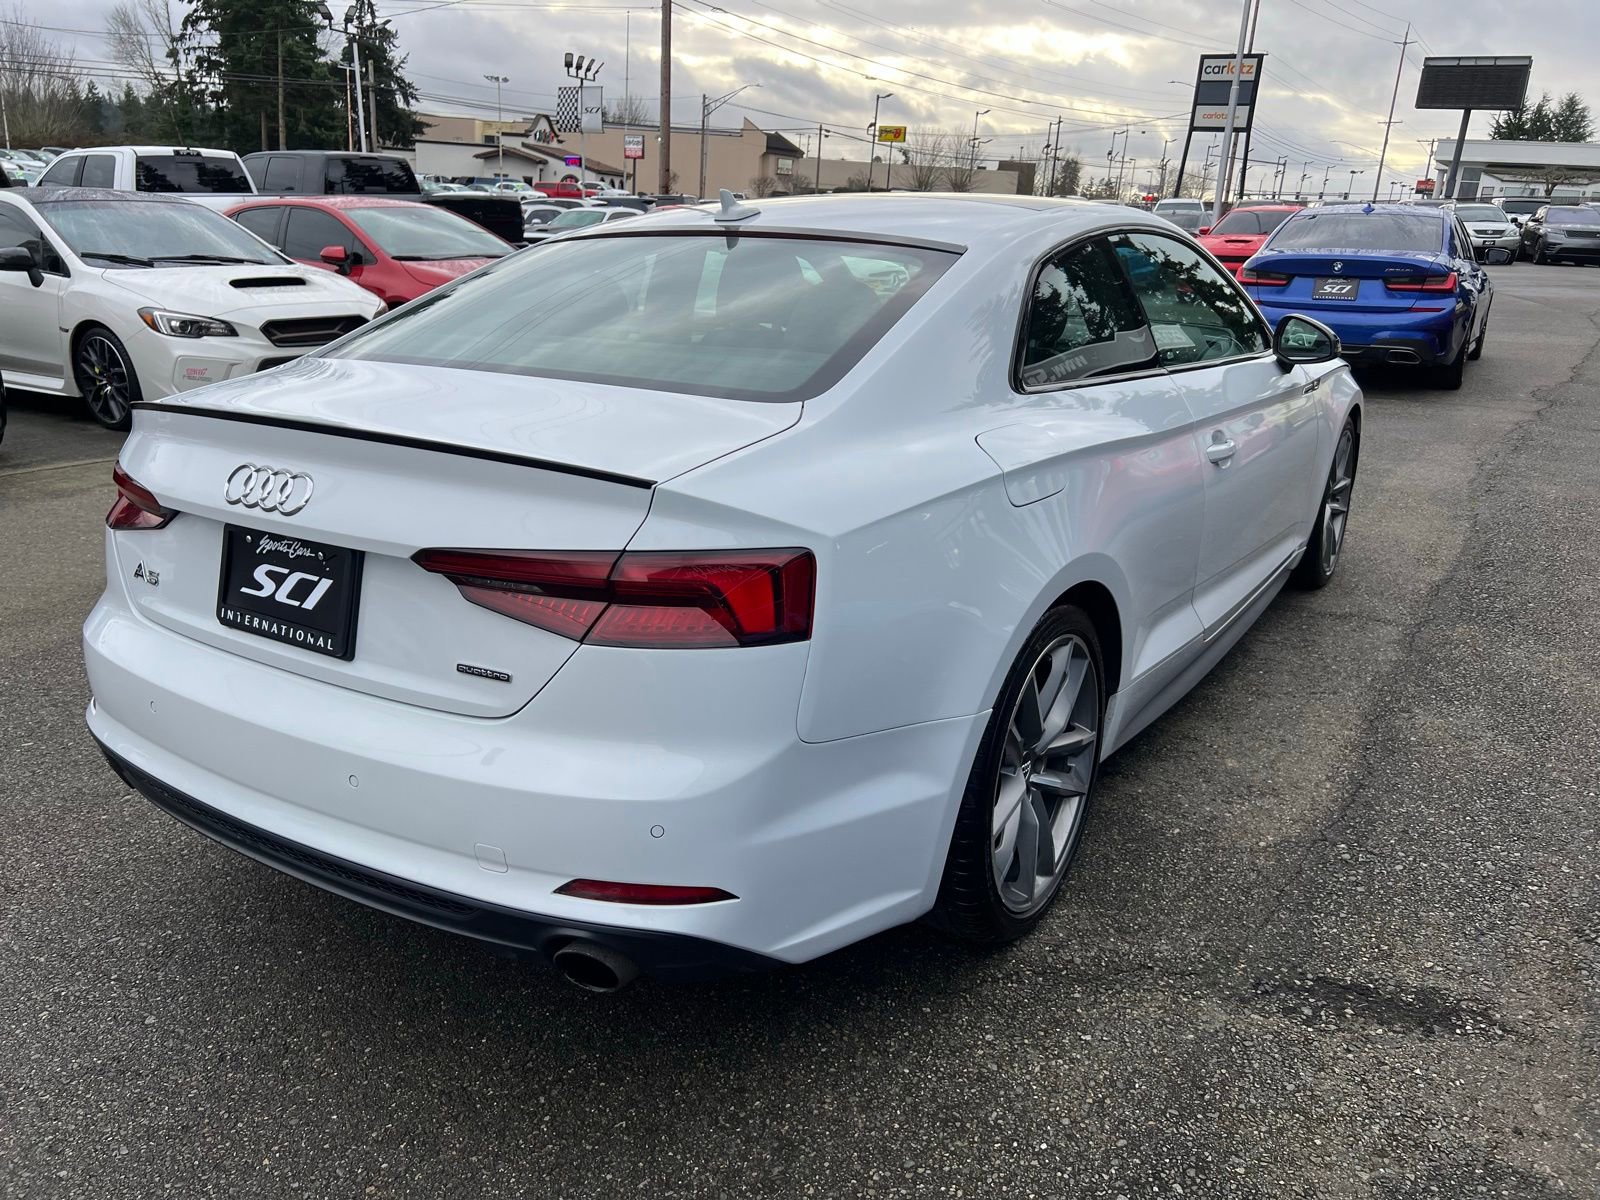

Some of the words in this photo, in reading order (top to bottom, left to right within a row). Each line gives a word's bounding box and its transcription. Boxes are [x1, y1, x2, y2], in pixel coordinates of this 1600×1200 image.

[1319, 284, 1353, 294] SCI
[255, 534, 290, 554] Sports
[287, 541, 316, 559] Cars
[134, 560, 160, 587] A5
[240, 563, 334, 611] SCI
[220, 607, 334, 651] INTERNATIONAL
[458, 665, 509, 681] quattro
